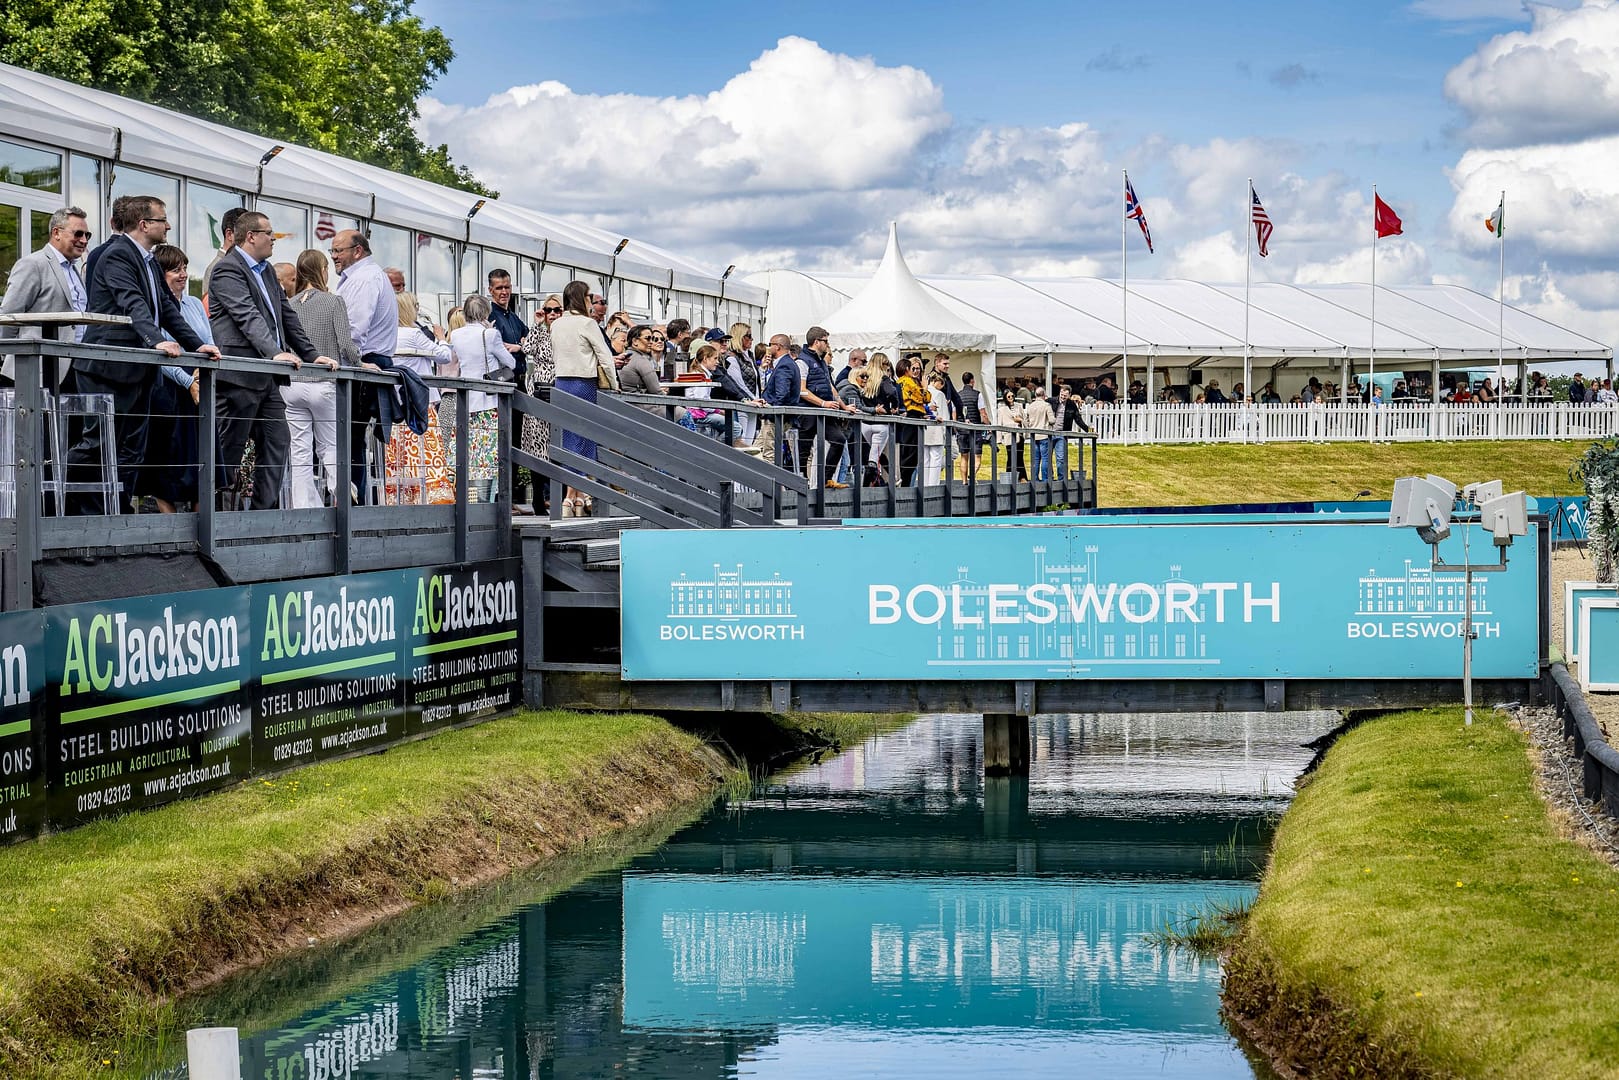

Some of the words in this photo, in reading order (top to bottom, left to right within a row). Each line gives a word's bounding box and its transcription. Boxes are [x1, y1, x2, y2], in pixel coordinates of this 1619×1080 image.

[261, 586, 396, 661] ACJackson
[412, 570, 518, 635] ACJackson
[868, 583, 1280, 625] BOLESWORTH
[60, 606, 240, 697] ACJackson
[659, 625, 805, 640] BOLESWORTH
[1346, 622, 1501, 638] BOLESWOTH
[412, 663, 437, 685] STEEL
[440, 656, 476, 680] BUILDING
[478, 648, 518, 671] SOLUTIONS
[415, 686, 447, 704] EQUESTRIAN
[450, 678, 486, 697] AGRICULTURAL
[491, 671, 517, 687] INDUSTRIAL
[261, 693, 293, 717] STEEL
[297, 683, 343, 710] BUILDING
[347, 672, 397, 699] SOLUTIONS
[458, 687, 511, 715] www.acjackson.co.uk
[60, 732, 104, 762] STEEL
[110, 718, 173, 752] BUILDING
[178, 703, 241, 737] SOLUTIONS
[264, 718, 307, 739] EQUESTRIAN
[311, 707, 356, 729] AGRICULTURAL
[362, 698, 396, 717] INDUSTRIAL
[273, 742, 292, 761] 01829
[292, 737, 313, 757] 423123
[321, 717, 388, 749] www.acjackson.co.uk
[64, 760, 123, 787] EQUESTRIAN
[129, 745, 191, 773] AGRICULTURAL
[200, 733, 240, 756] INDUSTRIAL
[77, 790, 102, 812] 01829
[103, 783, 131, 805] 423123
[143, 755, 231, 794] www.acjackson.co.uk
